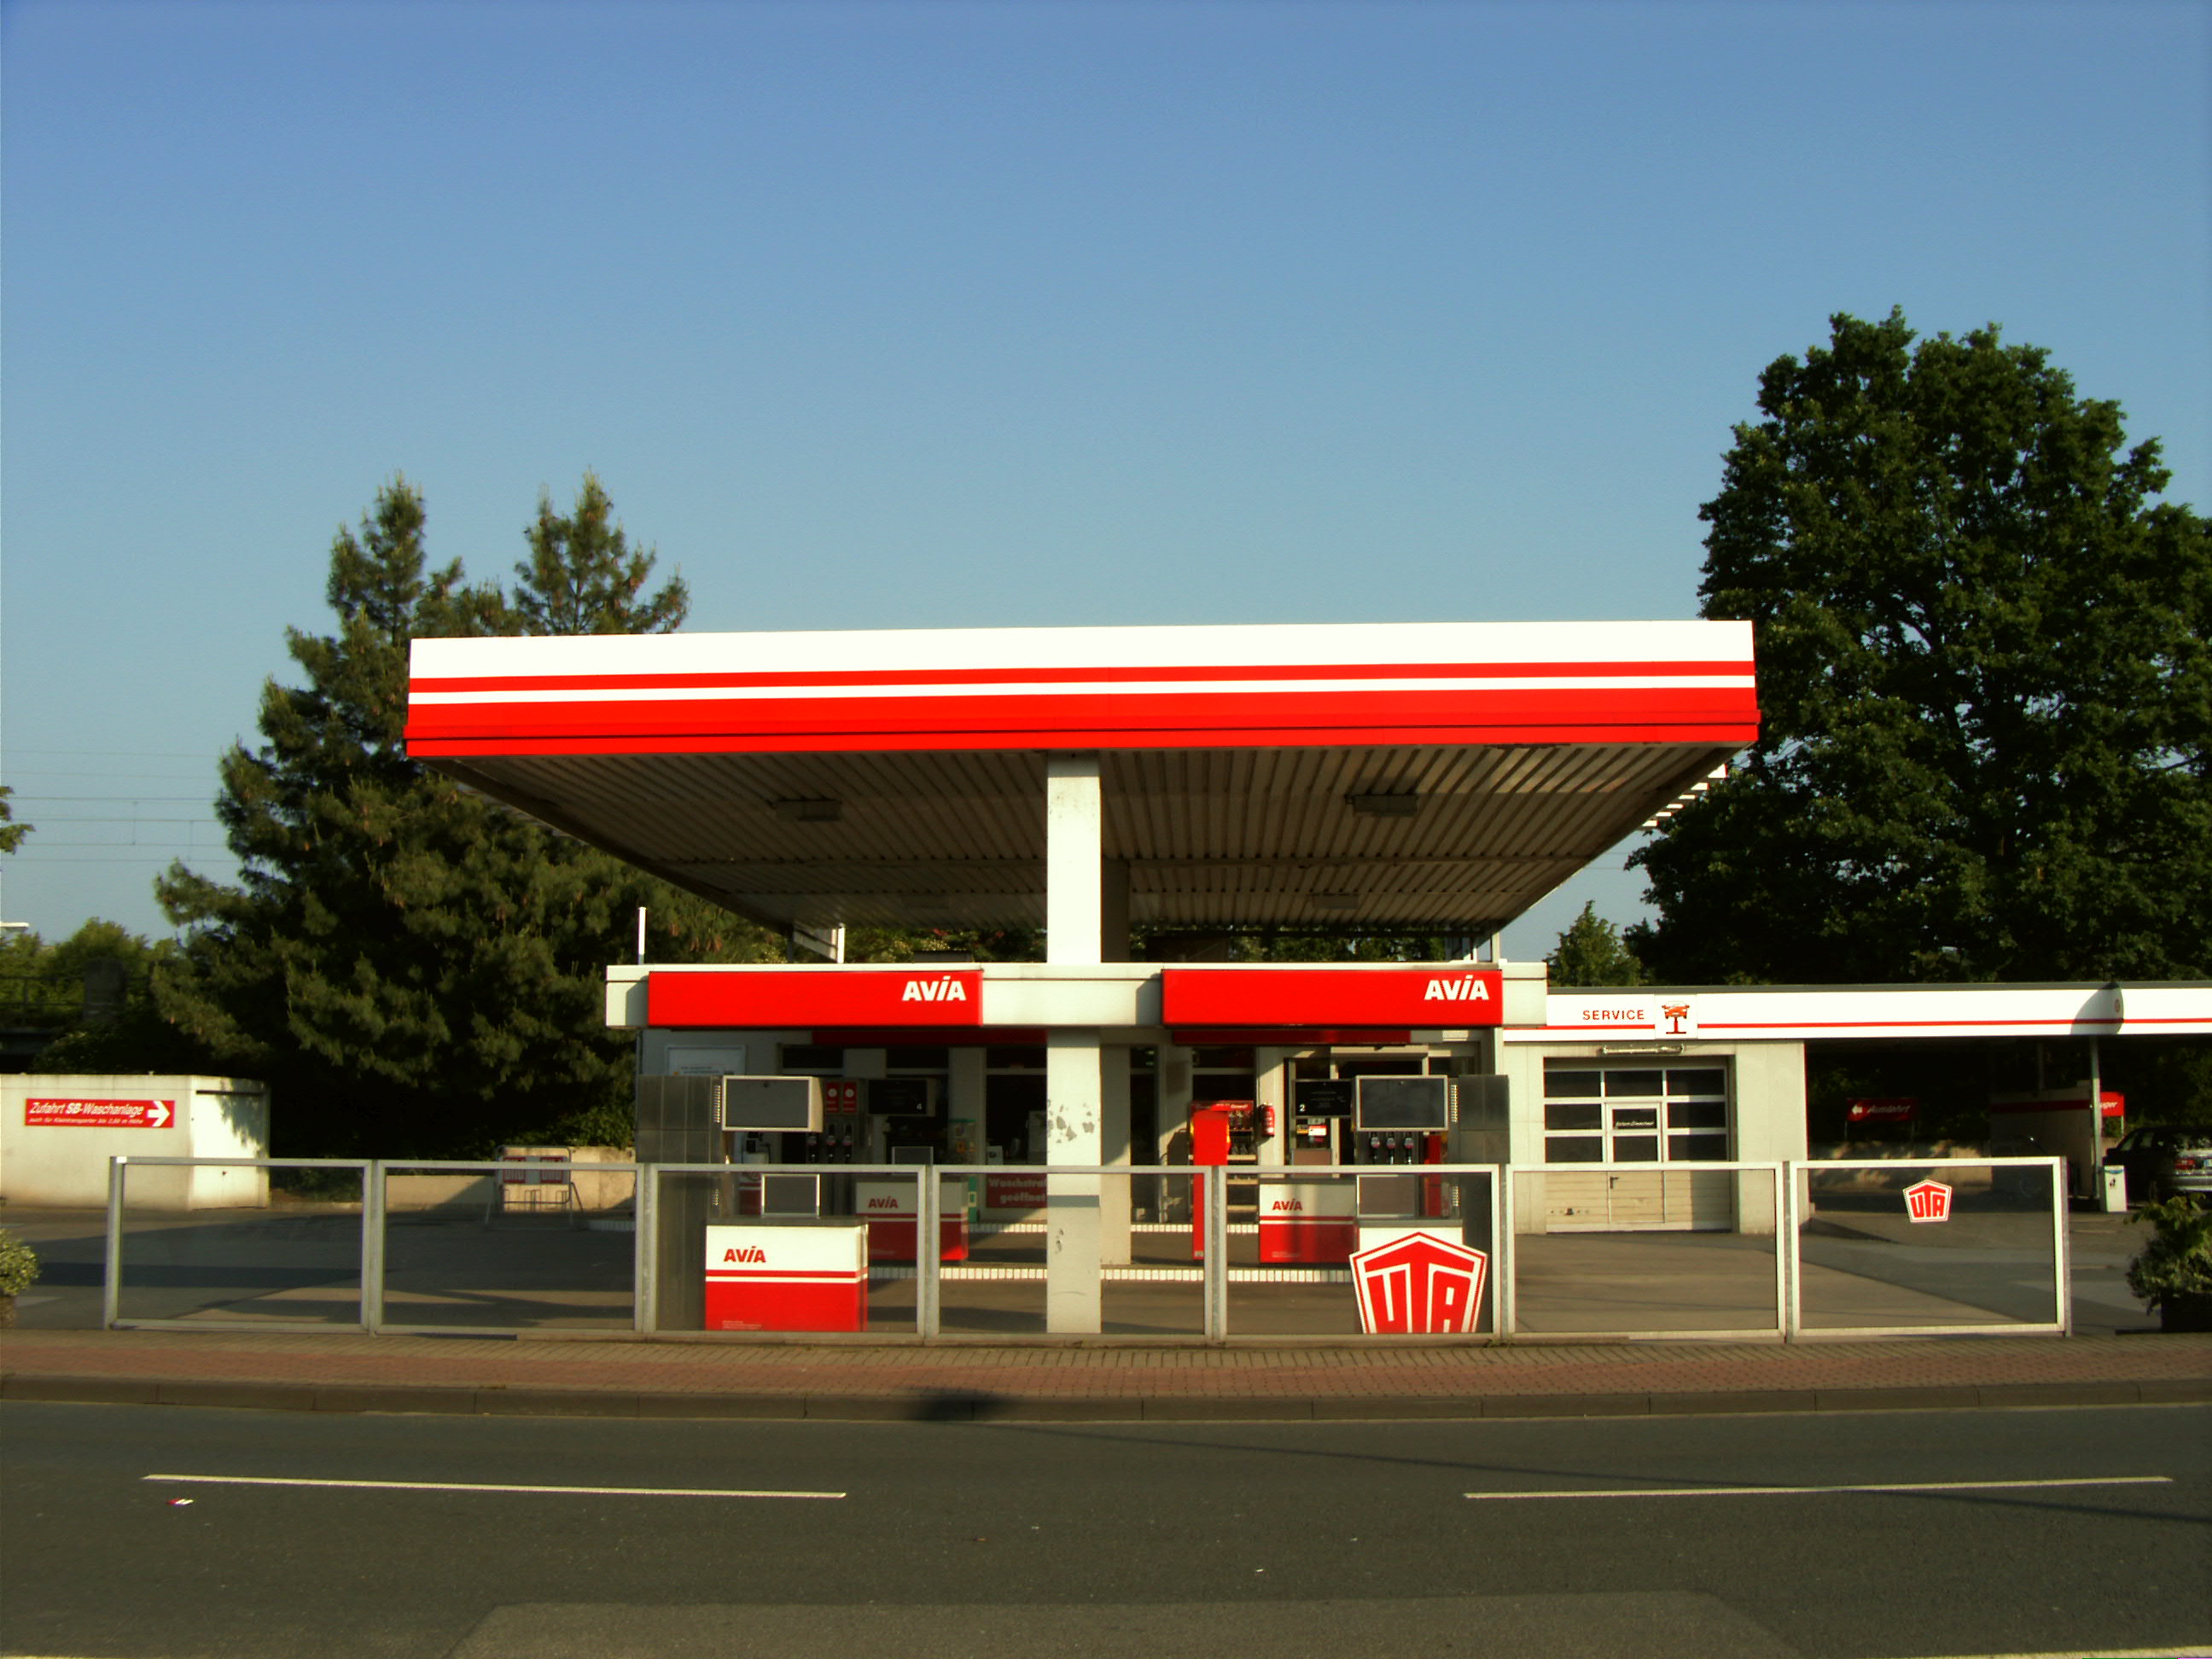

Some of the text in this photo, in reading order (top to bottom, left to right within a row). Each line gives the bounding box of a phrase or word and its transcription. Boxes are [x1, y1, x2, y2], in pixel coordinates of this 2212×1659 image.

[902, 975, 966, 1001] AVIA
[1424, 975, 1489, 1000] AVIA
[1583, 1010, 1644, 1020] SERVICE
[29, 1102, 143, 1117] Zufahrt SB-Waschanlage
[1299, 1103, 1306, 1112] 2
[868, 1196, 899, 1208] AVIA
[1272, 1198, 1302, 1211] AVIA
[1908, 1184, 1947, 1219] UTA
[723, 1245, 766, 1263] AVIA
[1364, 1241, 1476, 1334] UTA
